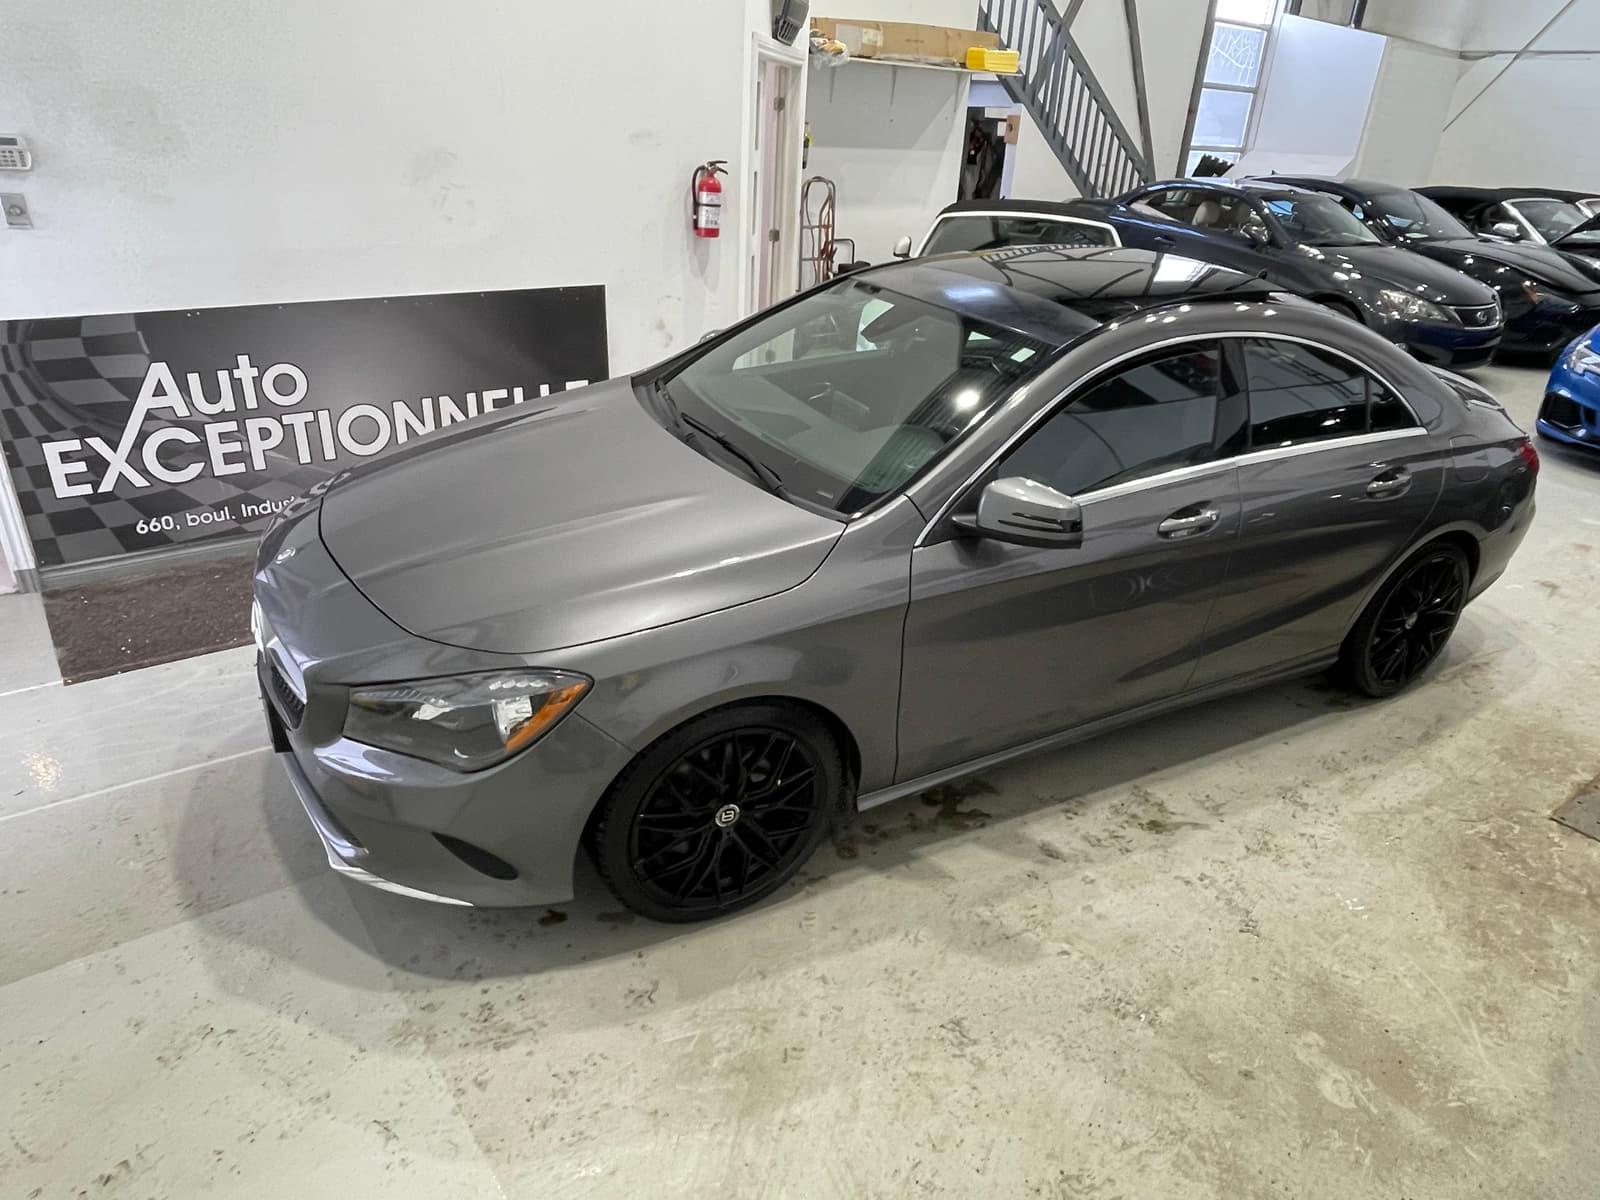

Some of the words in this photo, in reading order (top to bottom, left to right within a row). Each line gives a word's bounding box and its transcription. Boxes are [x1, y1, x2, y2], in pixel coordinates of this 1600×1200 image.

[137, 354, 309, 419] Auto
[41, 379, 589, 499] EXCEPTIONN
[135, 515, 181, 535] 660,
[186, 506, 236, 527] boul.
